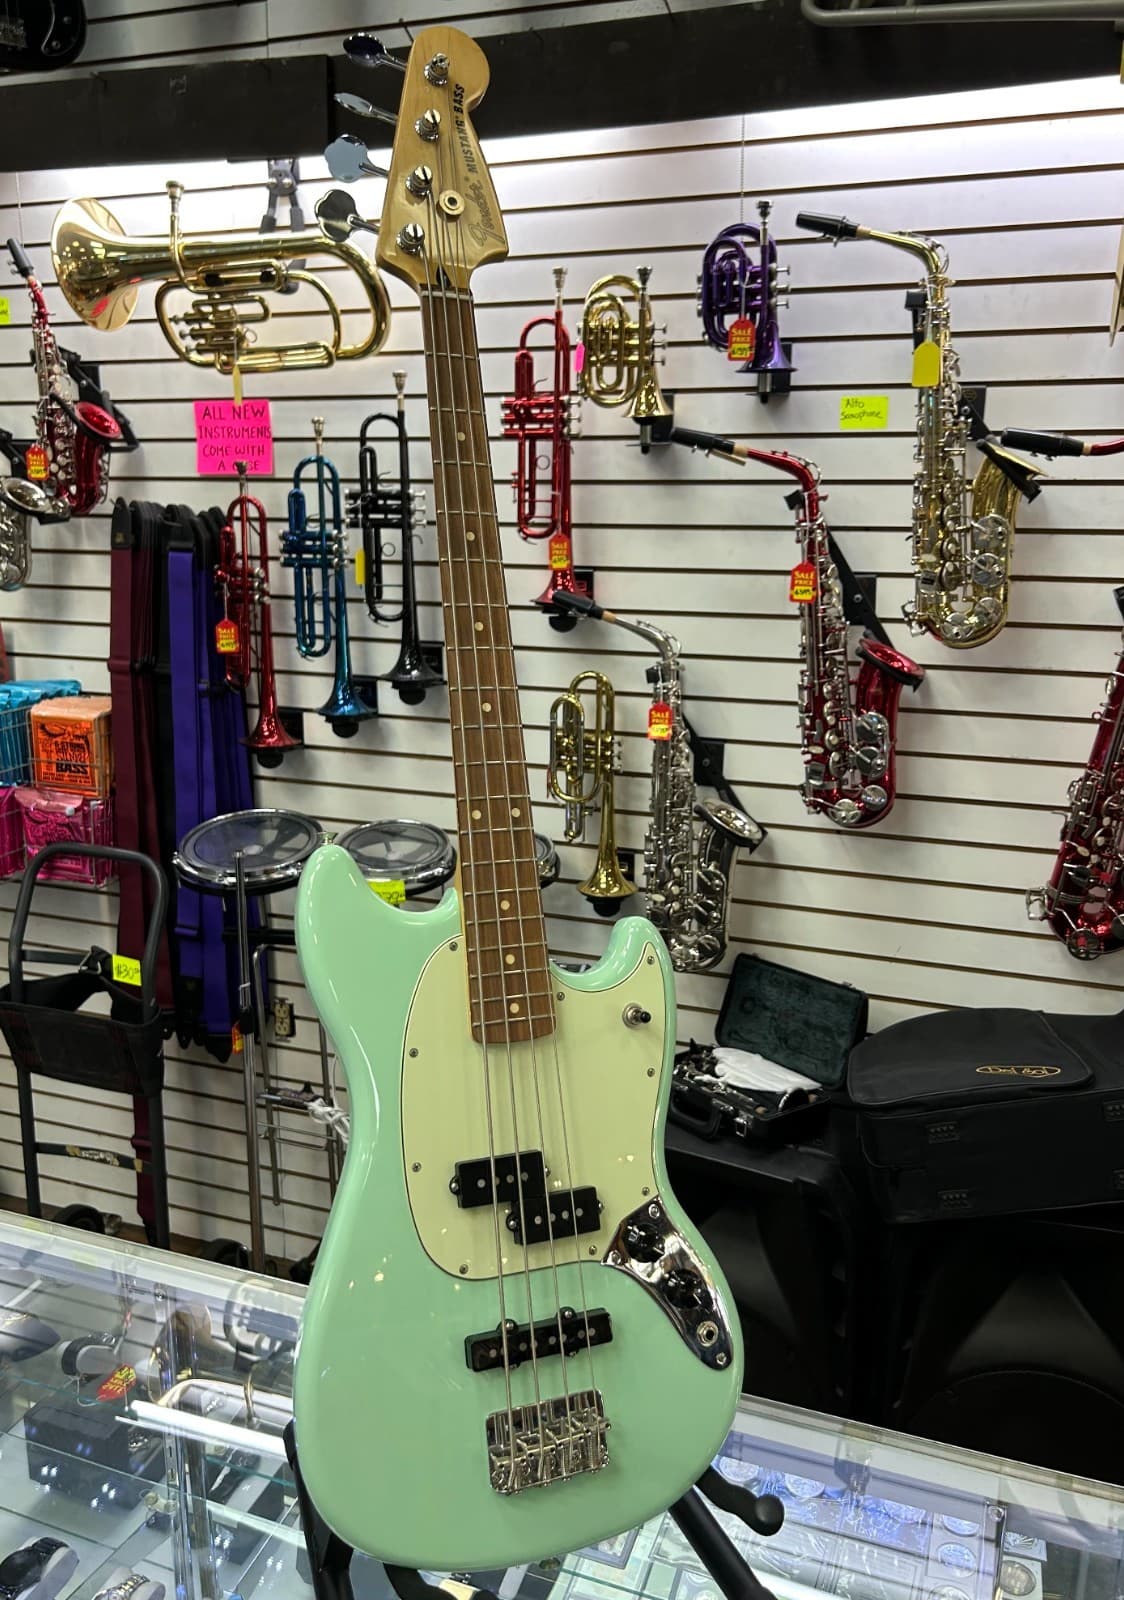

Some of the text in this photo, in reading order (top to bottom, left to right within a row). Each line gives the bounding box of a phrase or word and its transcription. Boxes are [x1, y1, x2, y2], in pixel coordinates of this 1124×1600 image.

[453, 84, 478, 174] MUSTANG BASS
[465, 180, 506, 247] Fender
[731, 327, 752, 336] SALE
[203, 404, 265, 420] ALL NEW
[203, 444, 265, 457] COME WITH
[218, 460, 226, 471] A
[794, 570, 814, 579] SALE
[651, 710, 669, 718] SALE
[55, 762, 89, 775] BASS
